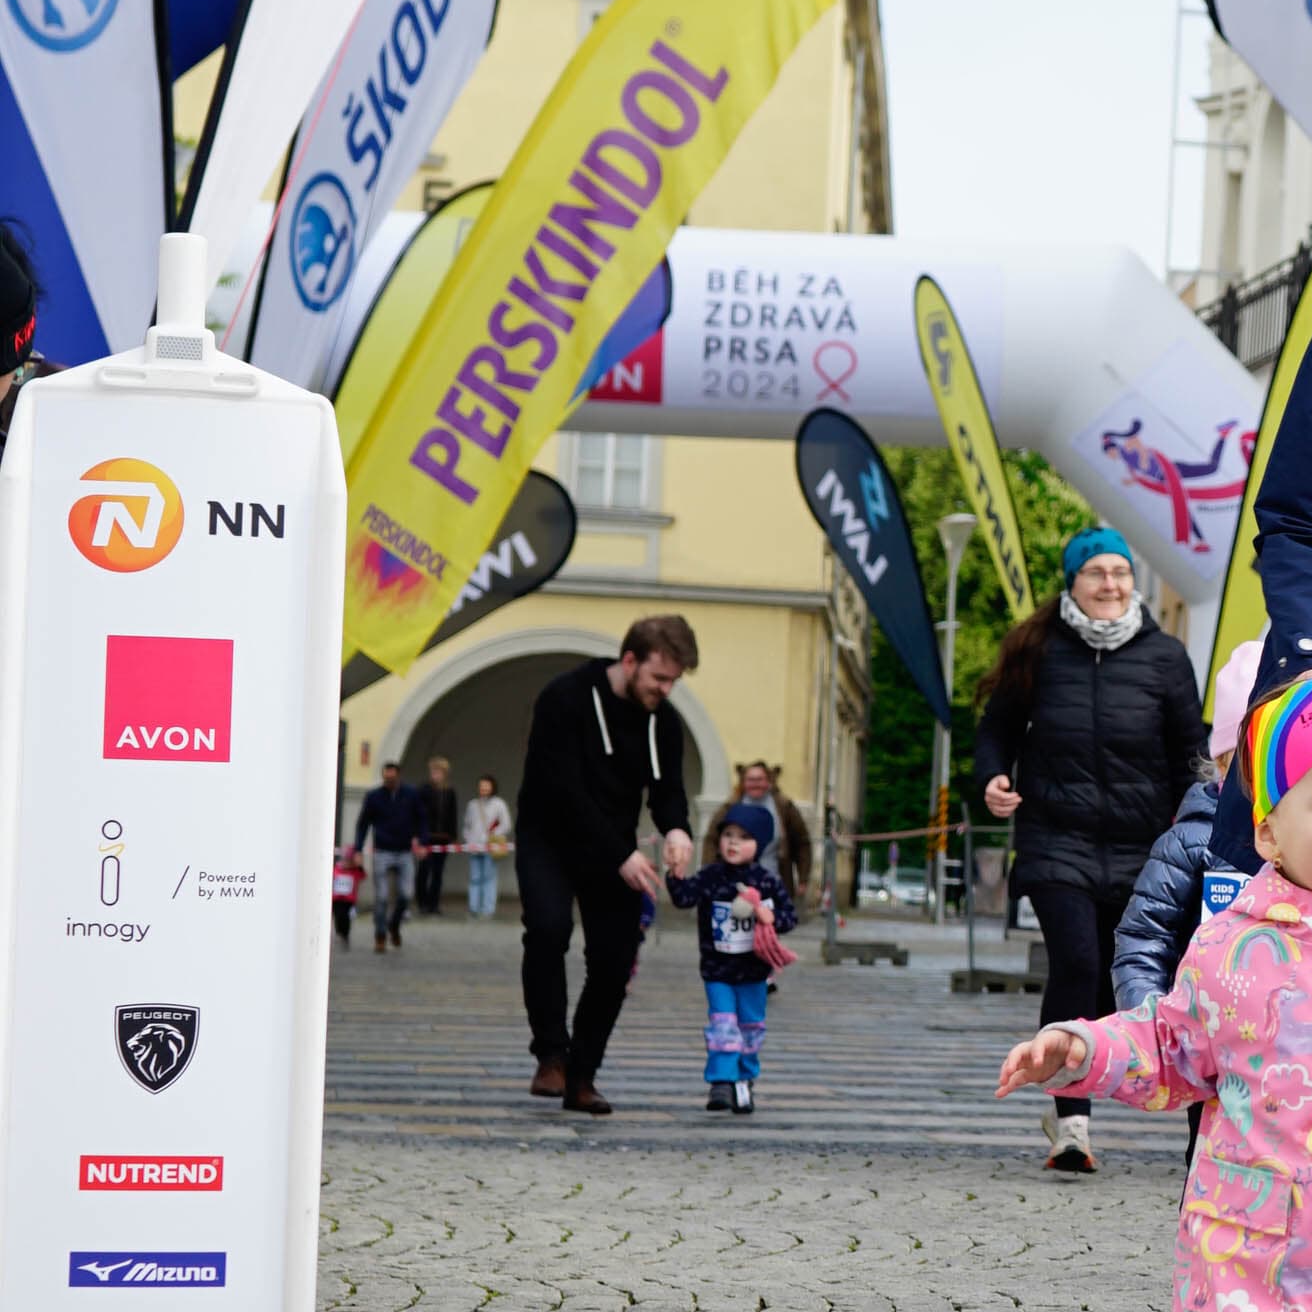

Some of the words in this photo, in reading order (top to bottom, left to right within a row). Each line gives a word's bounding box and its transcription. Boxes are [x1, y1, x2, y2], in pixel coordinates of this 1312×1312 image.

[409, 39, 729, 506] PERSKINDOL
[707, 265, 779, 296] BĚH
[799, 271, 844, 298] ZA
[704, 299, 857, 333] ZDRAVÁ
[703, 336, 797, 365] PRSA
[703, 369, 799, 400] 2024
[208, 500, 286, 539] NN
[449, 530, 538, 615] AWI
[115, 725, 215, 751] AVON
[199, 871, 256, 884] Powered
[1211, 884, 1234, 894] KIDS
[199, 887, 215, 900] by
[220, 888, 255, 898] MVM
[1211, 894, 1232, 904] CUP
[66, 917, 150, 943] innogy
[122, 1011, 192, 1022] PEUGEOT
[86, 1163, 217, 1185] NUTREND
